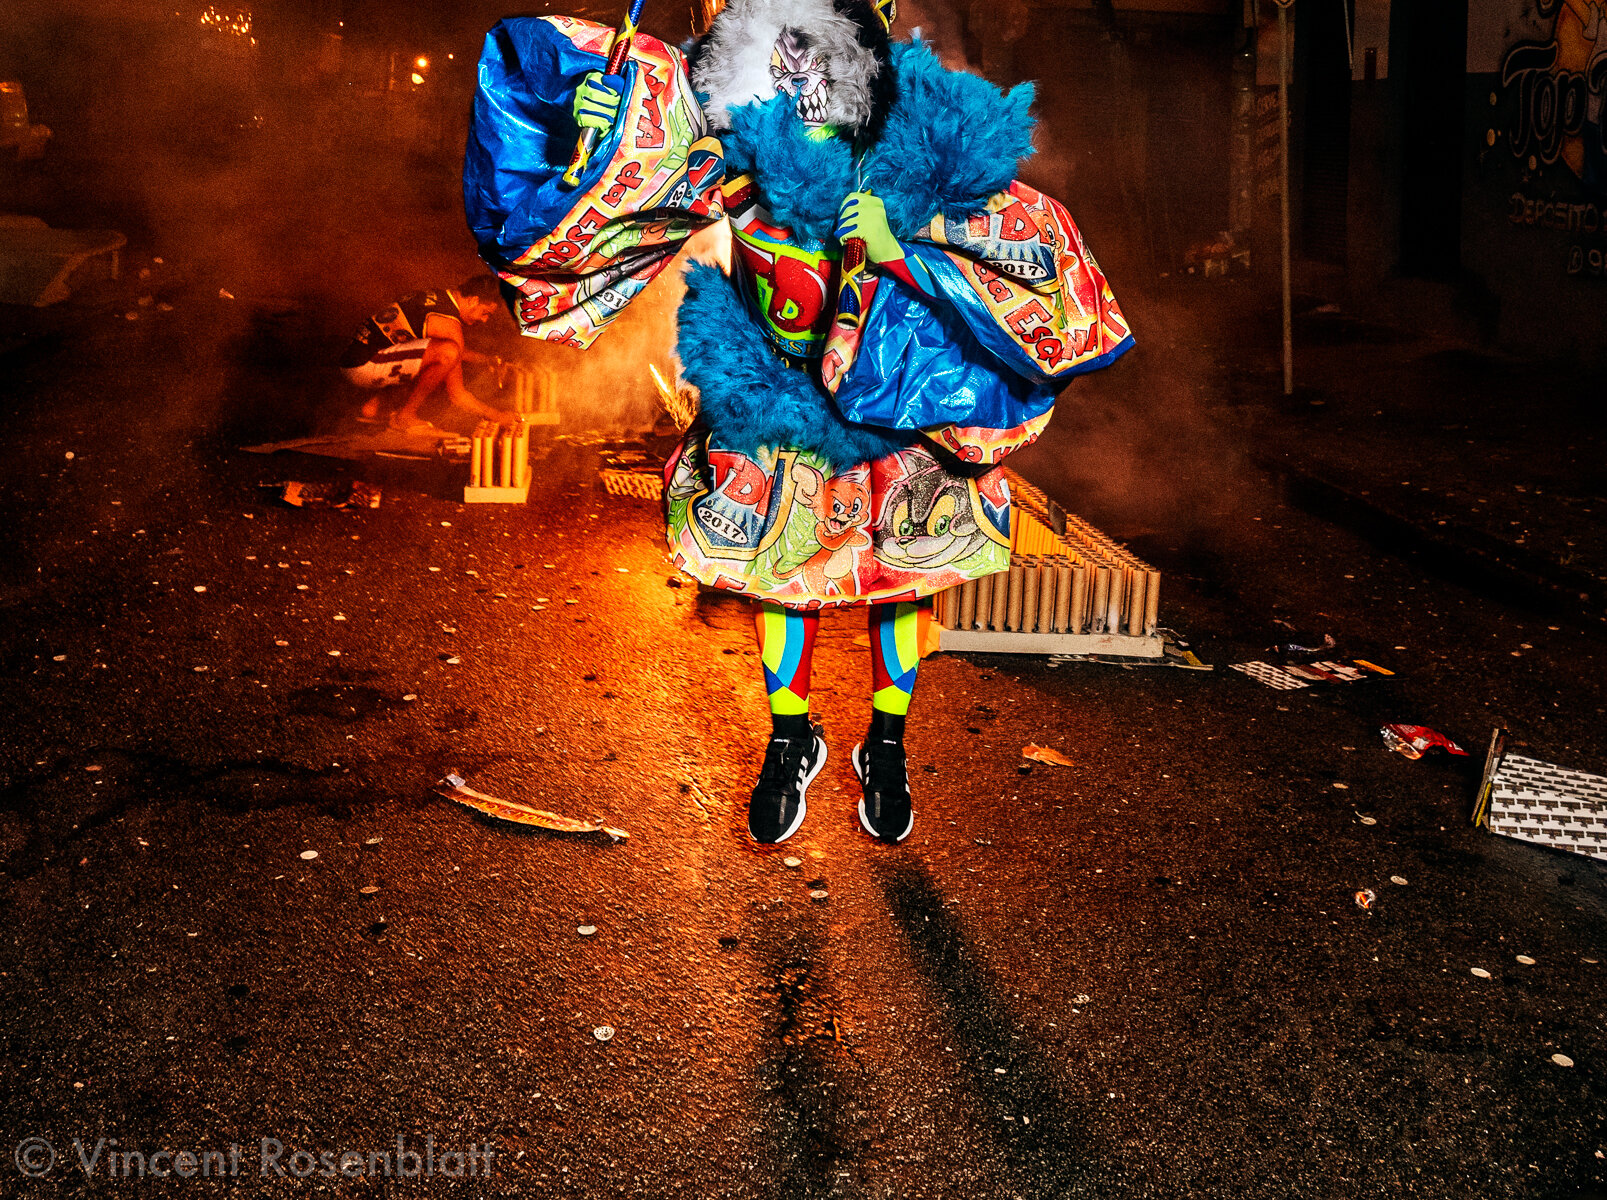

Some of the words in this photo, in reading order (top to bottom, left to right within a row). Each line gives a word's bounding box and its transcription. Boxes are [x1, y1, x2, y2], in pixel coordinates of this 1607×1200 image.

[601, 161, 644, 208] da
[973, 261, 1014, 303] da
[701, 510, 742, 540] 2017
